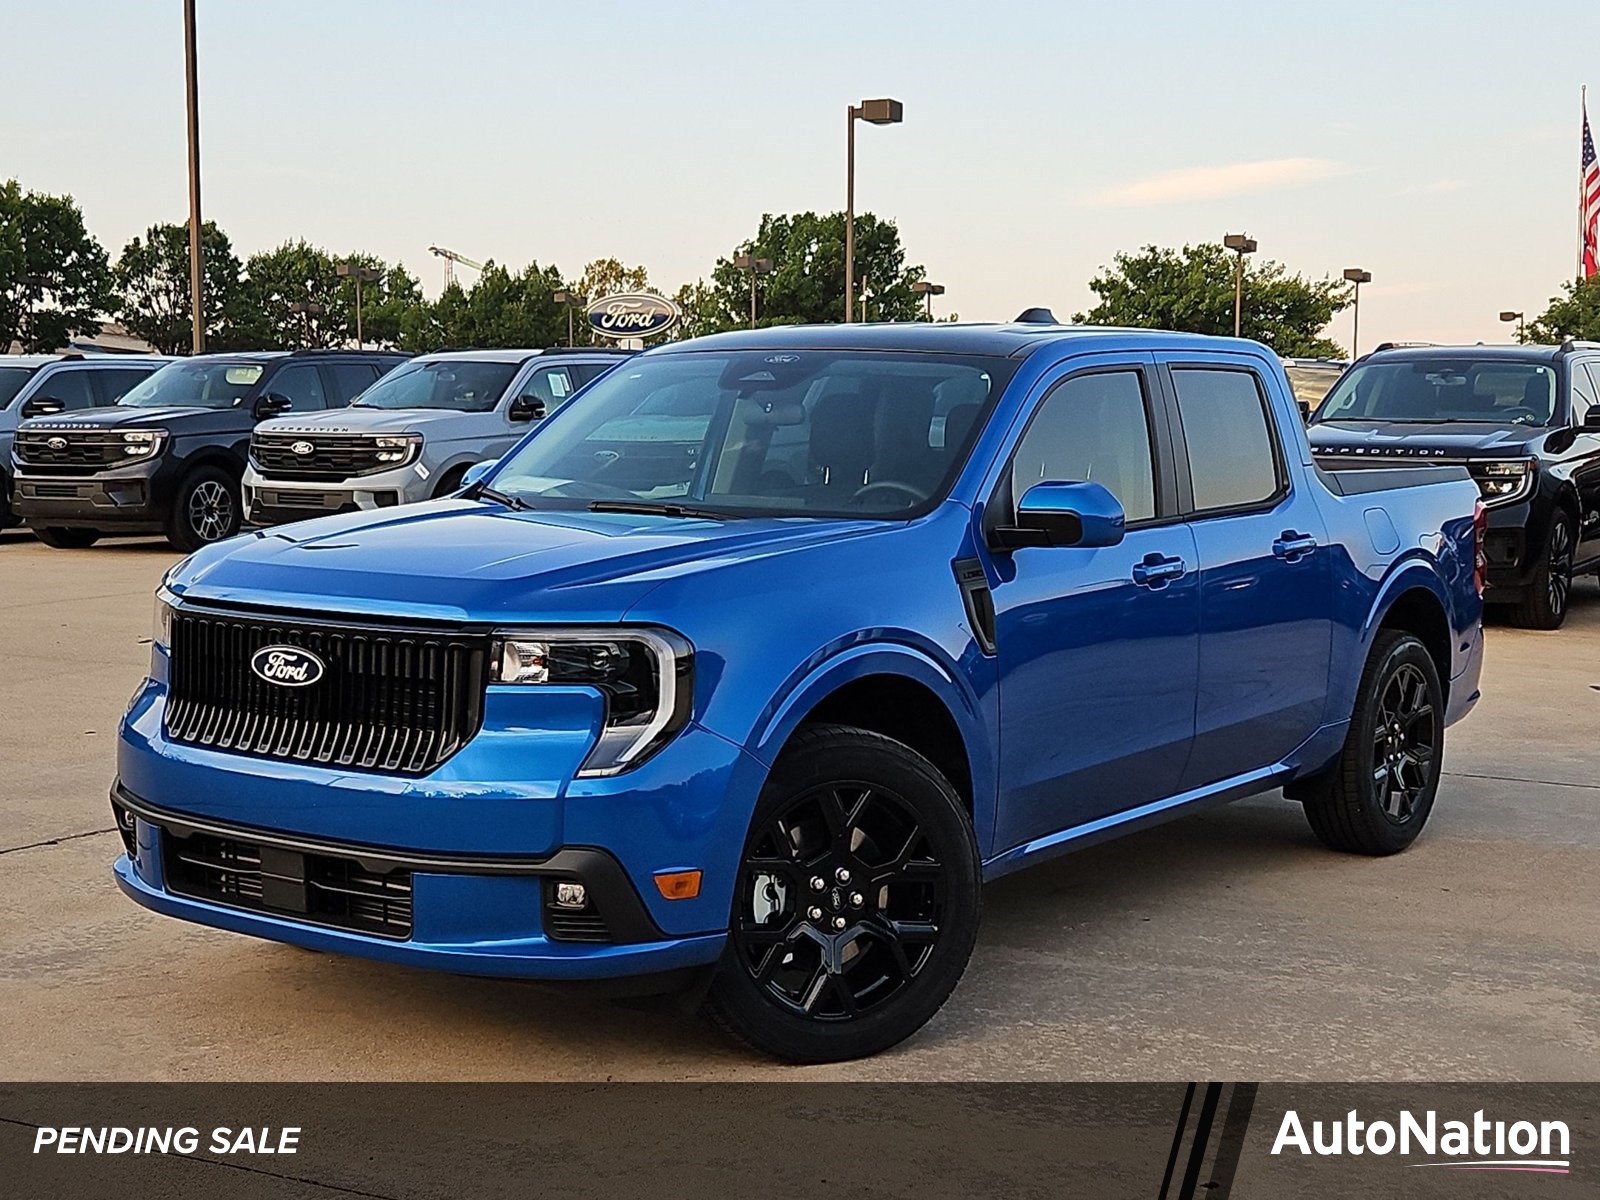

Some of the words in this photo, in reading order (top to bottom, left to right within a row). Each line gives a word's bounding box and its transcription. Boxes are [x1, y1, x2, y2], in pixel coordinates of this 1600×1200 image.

[601, 303, 656, 328] Ford
[1310, 447, 1446, 456] EXPEDITION
[264, 652, 309, 681] Ford
